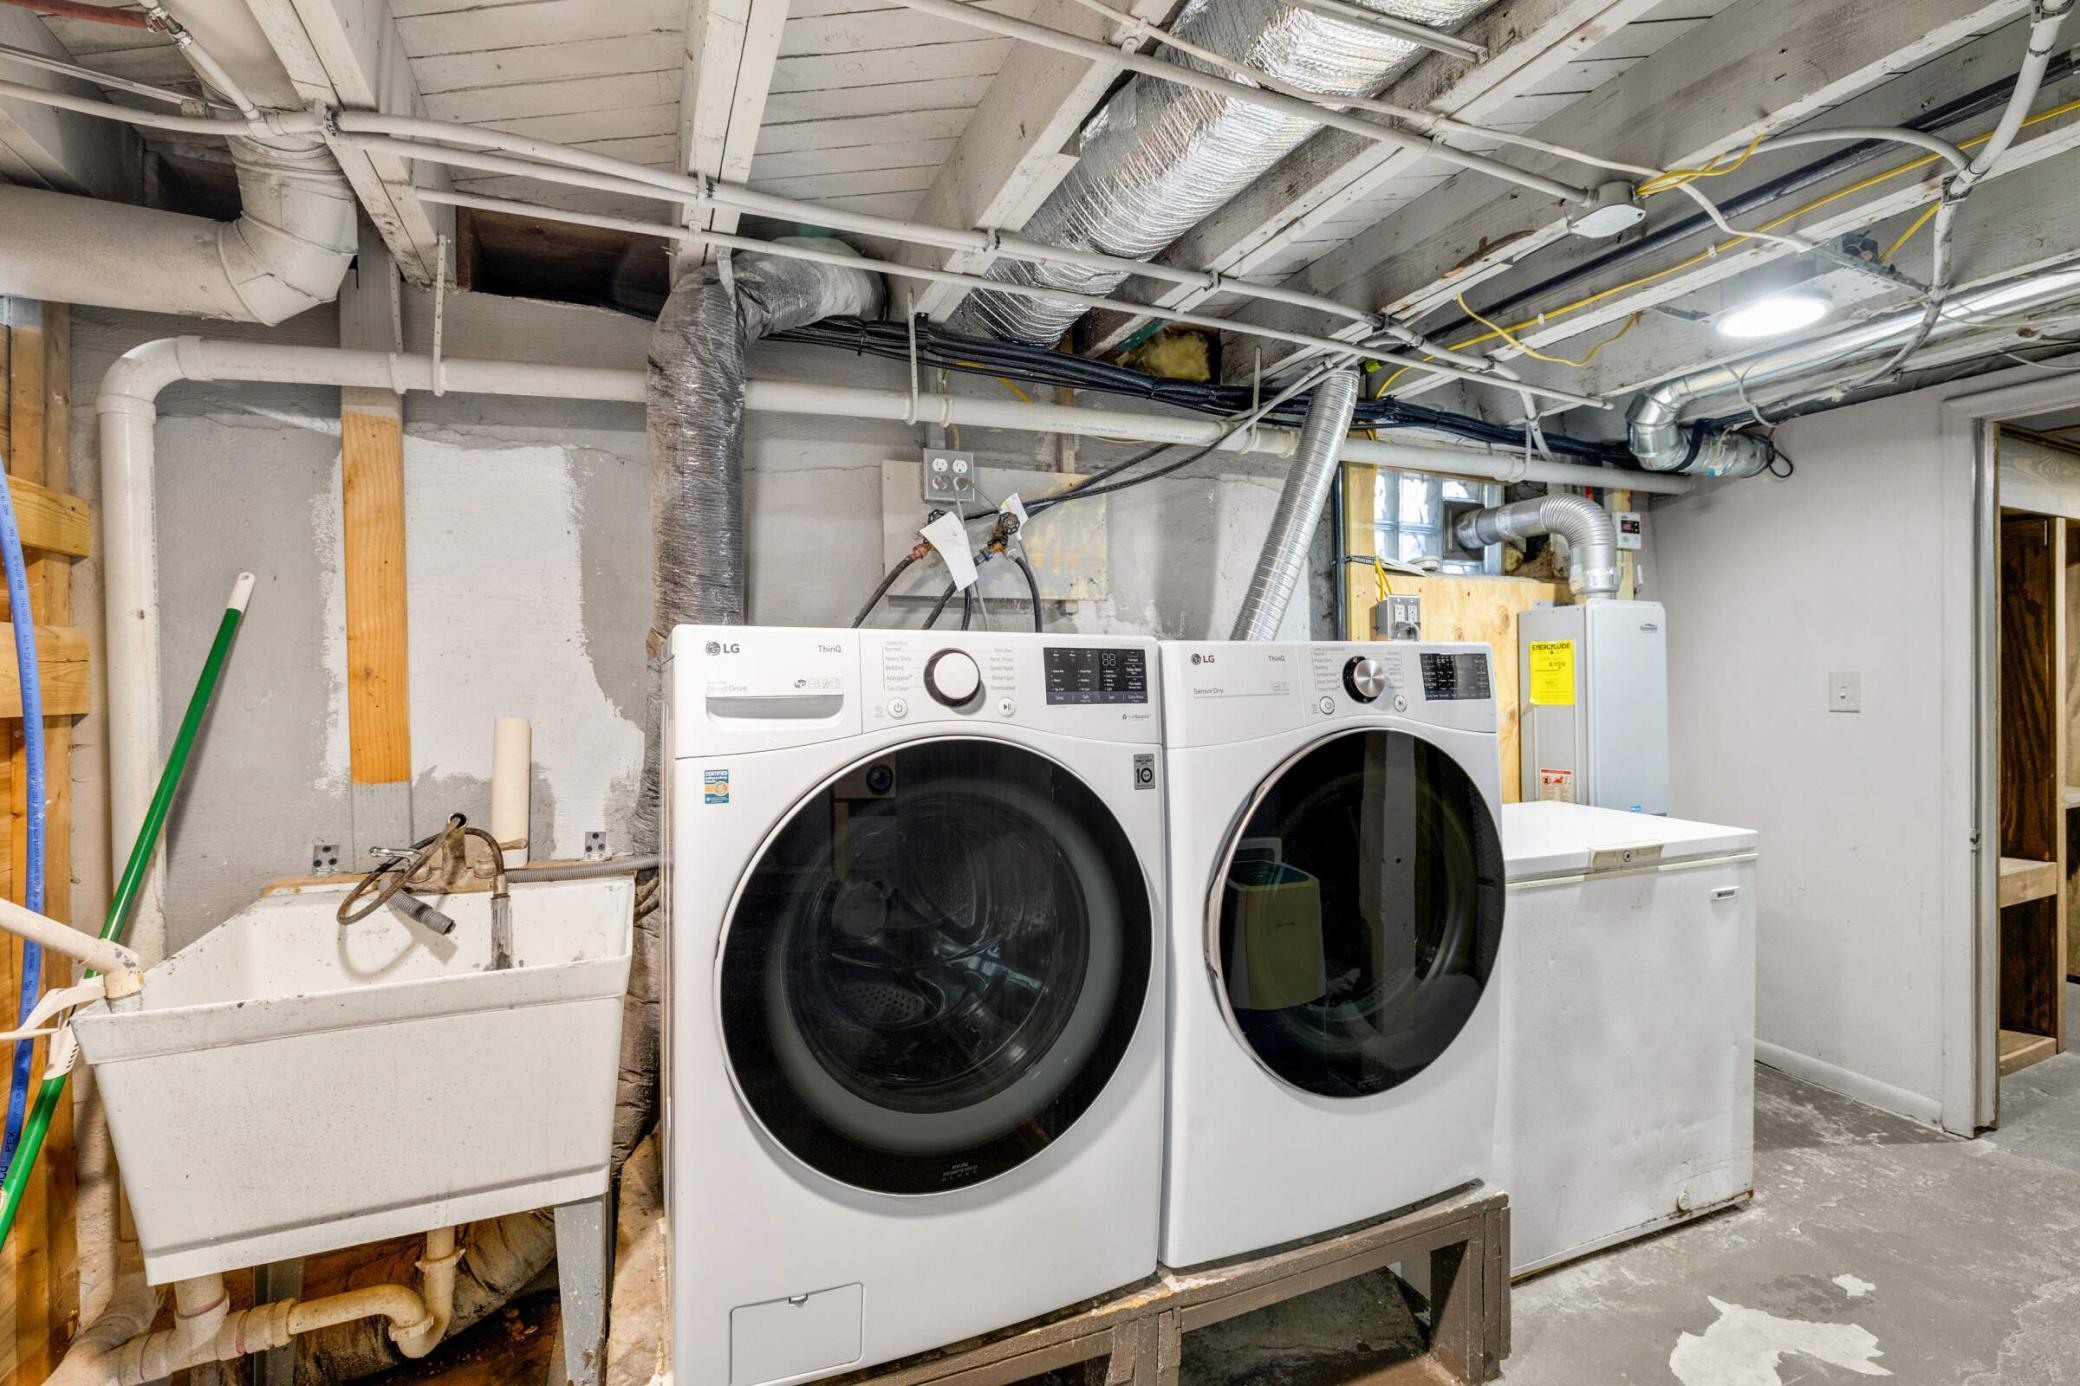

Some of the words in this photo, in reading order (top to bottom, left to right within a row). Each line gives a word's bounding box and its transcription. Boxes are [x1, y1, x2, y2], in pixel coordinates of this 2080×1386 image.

[722, 643, 740, 654] LG
[817, 644, 842, 653] ThinQ
[1202, 654, 1215, 664] LG
[5, 1131, 16, 1153] PEX
